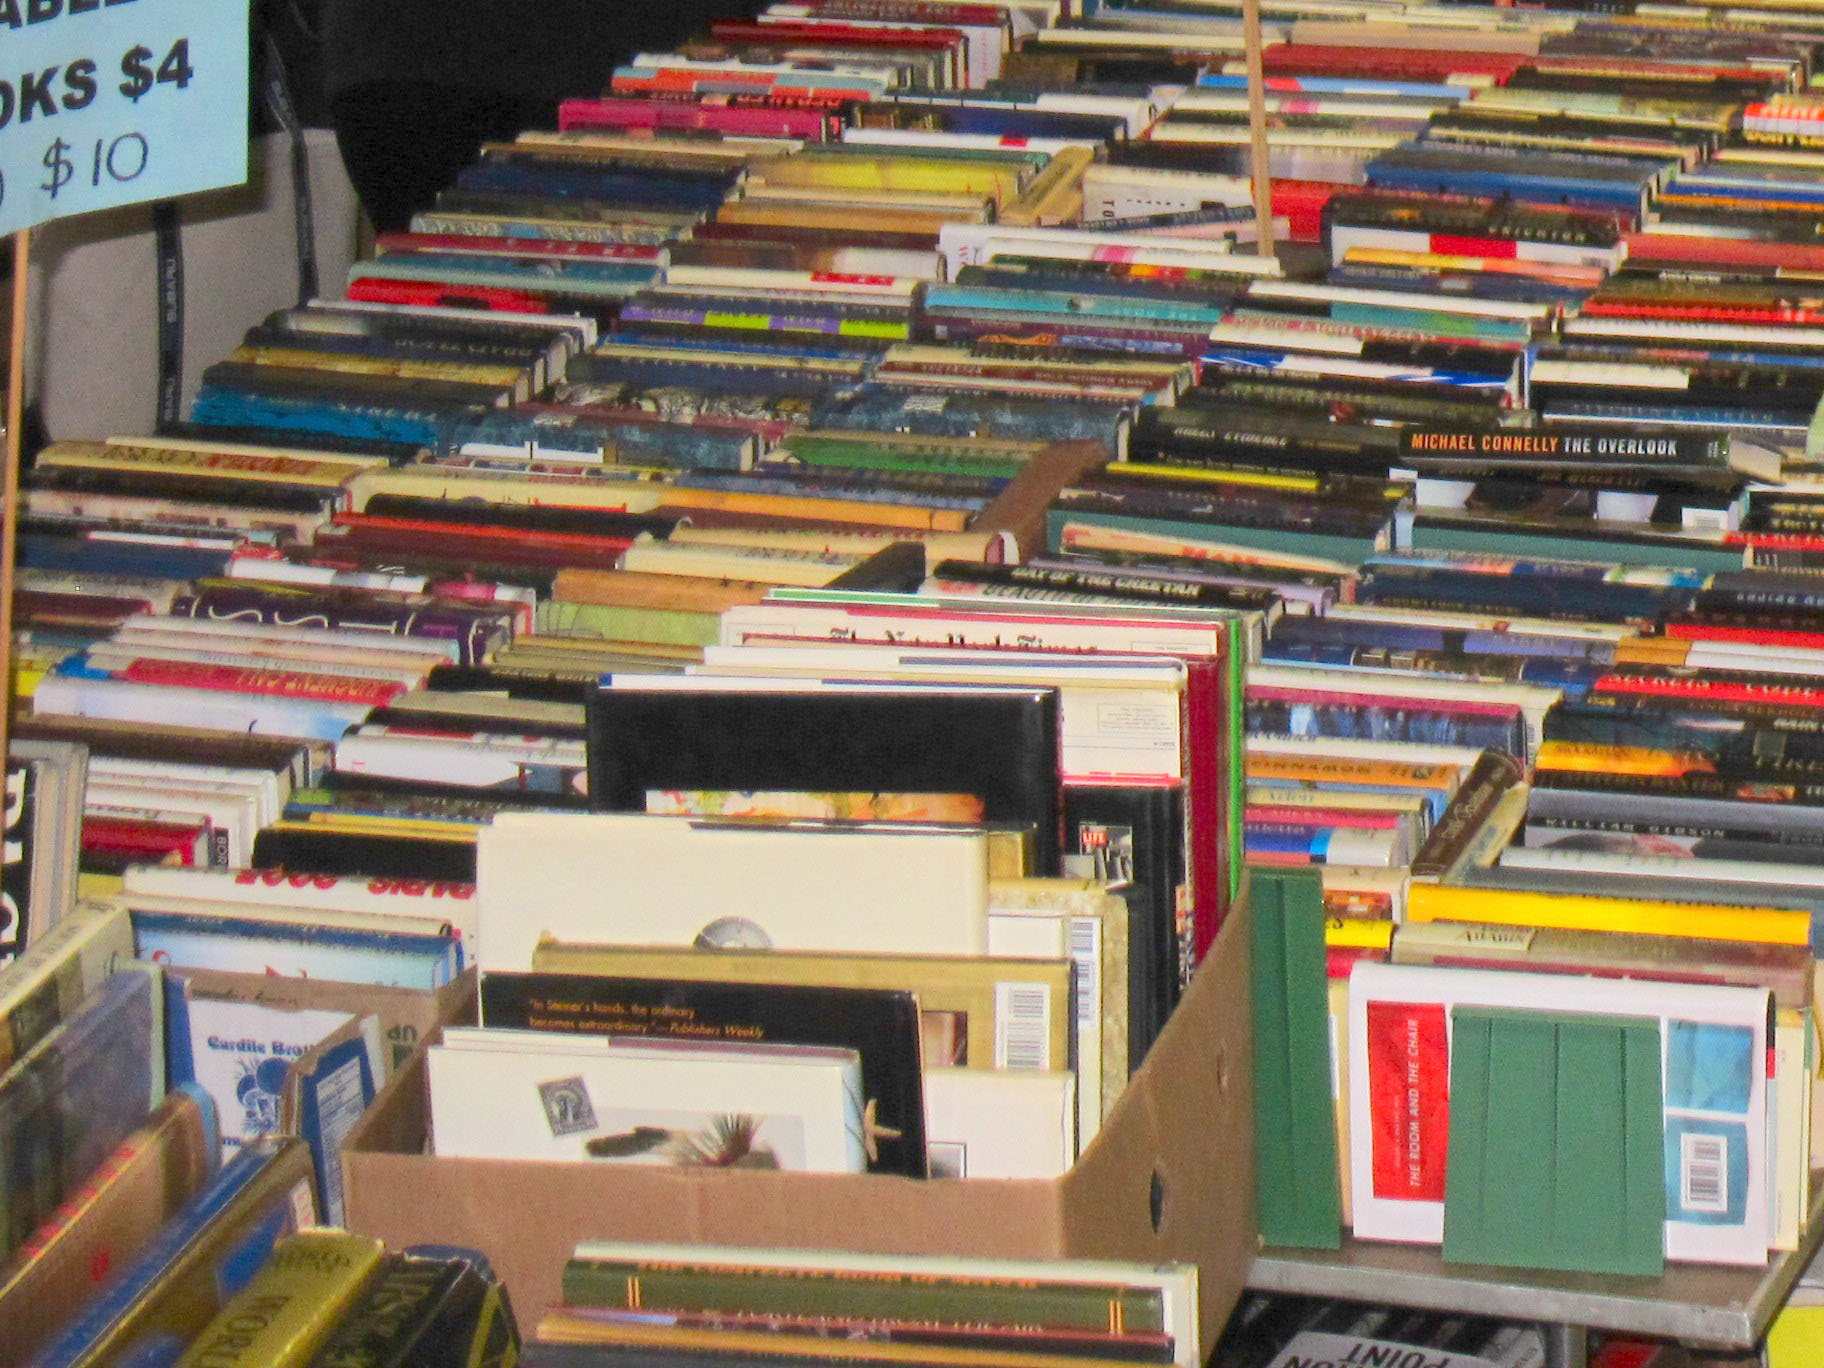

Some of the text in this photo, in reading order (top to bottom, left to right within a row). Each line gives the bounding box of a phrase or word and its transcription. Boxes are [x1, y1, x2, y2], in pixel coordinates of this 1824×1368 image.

[0, 59, 98, 130] KS
[119, 38, 194, 103] $4
[41, 131, 150, 200] $10
[1411, 433, 1678, 456] MICHAEL CONNELLY THE OVERLOOK
[1082, 831, 1107, 845] LIFE
[1407, 1019, 1421, 1187] THE ROOM AND THE CHAIR
